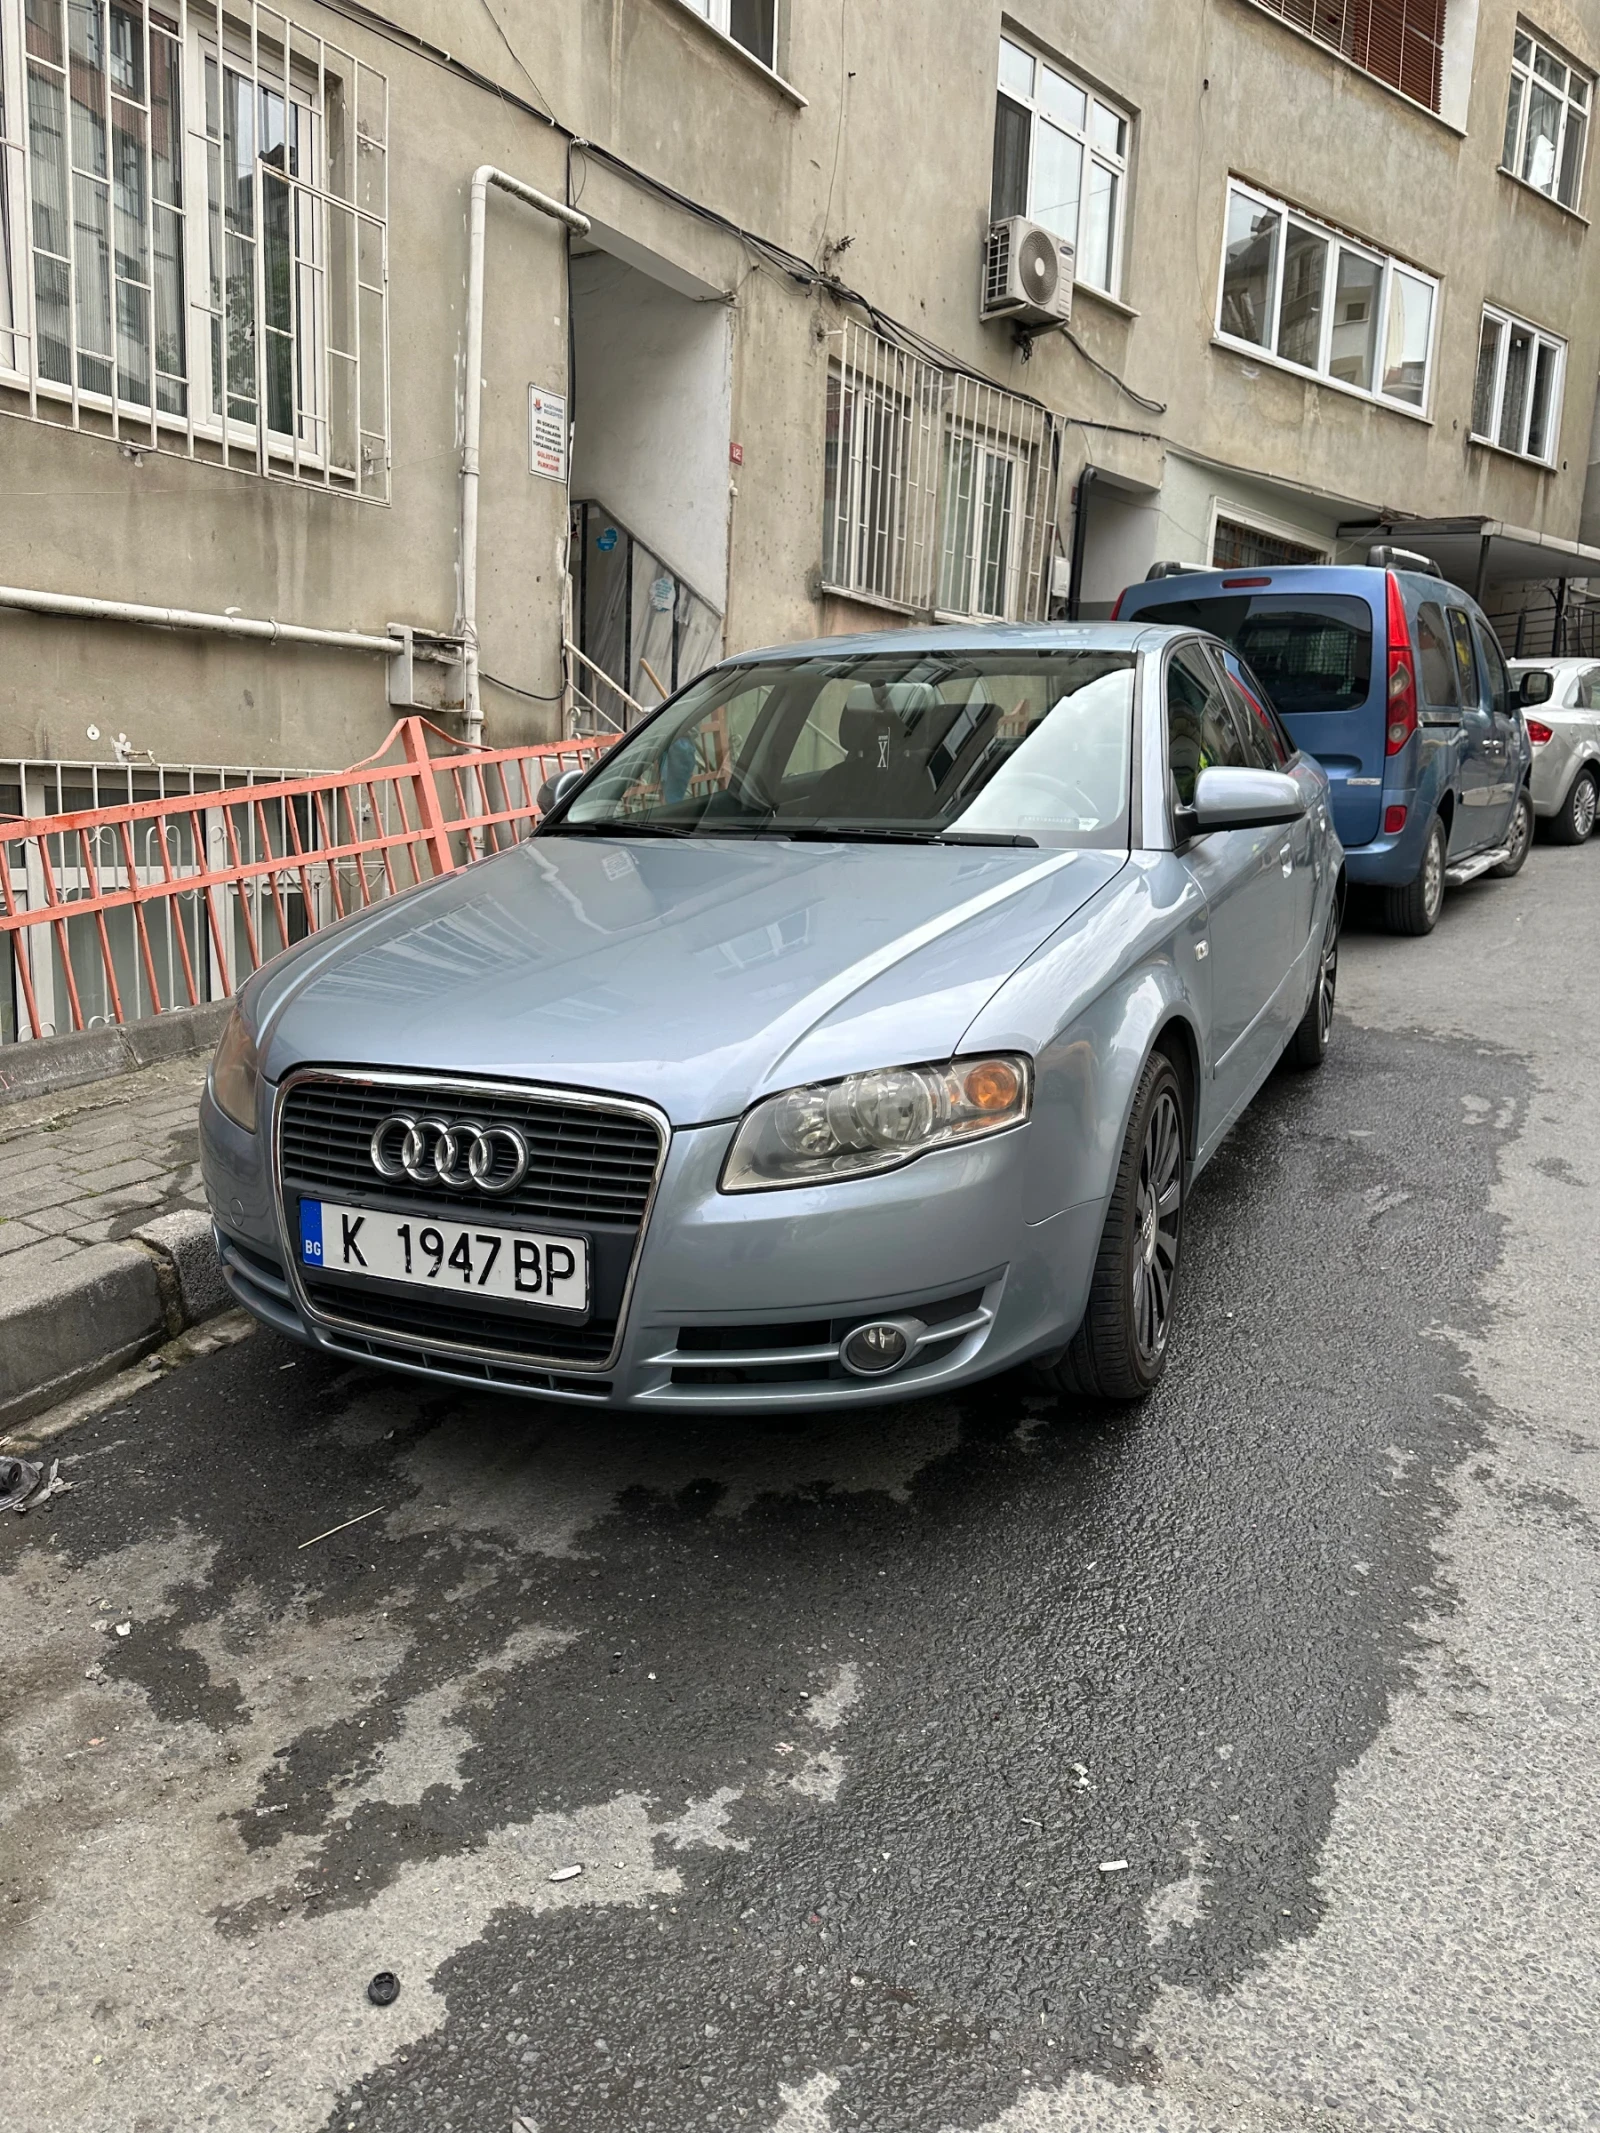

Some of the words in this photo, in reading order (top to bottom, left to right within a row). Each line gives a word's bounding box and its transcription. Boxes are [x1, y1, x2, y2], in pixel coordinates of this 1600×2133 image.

[305, 1239, 321, 1255] BG
[341, 1213, 368, 1267] K
[397, 1223, 502, 1286] 1947
[513, 1239, 576, 1296] BP
